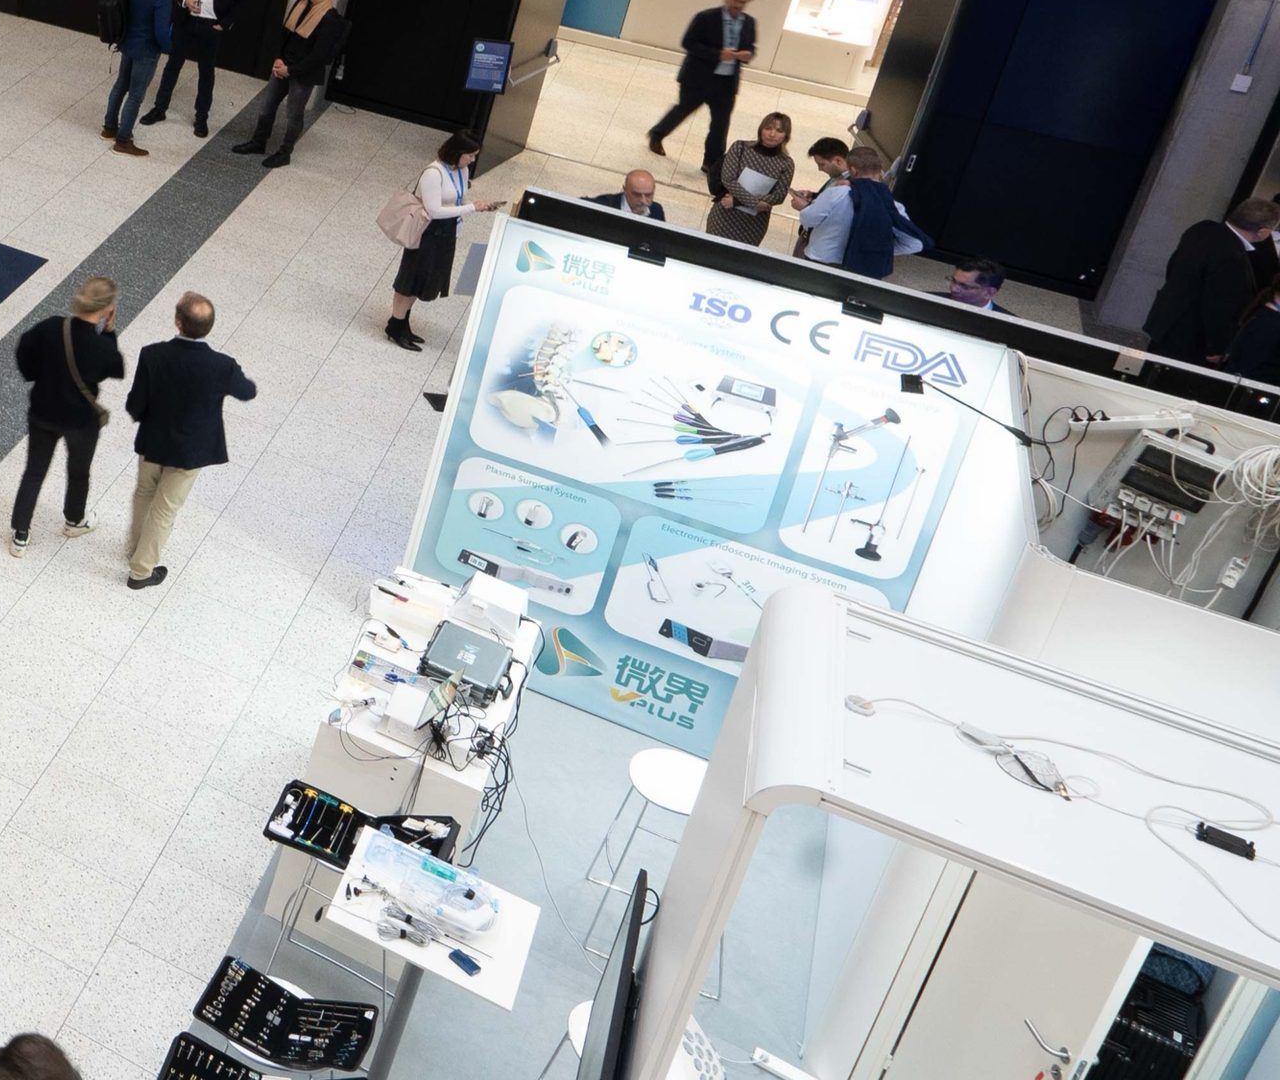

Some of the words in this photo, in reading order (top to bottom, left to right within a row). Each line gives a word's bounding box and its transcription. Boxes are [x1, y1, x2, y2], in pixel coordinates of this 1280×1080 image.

[689, 292, 752, 323] ISO
[853, 331, 967, 387] FDA
[485, 464, 516, 480] Plasma
[518, 475, 553, 493] Surgical
[554, 488, 587, 504] System
[661, 523, 708, 545] Electronic
[709, 539, 765, 566] Endoscopic
[766, 558, 809, 580] Imaging
[810, 572, 848, 592] System
[741, 579, 757, 594] 3m
[615, 655, 710, 714] 微界
